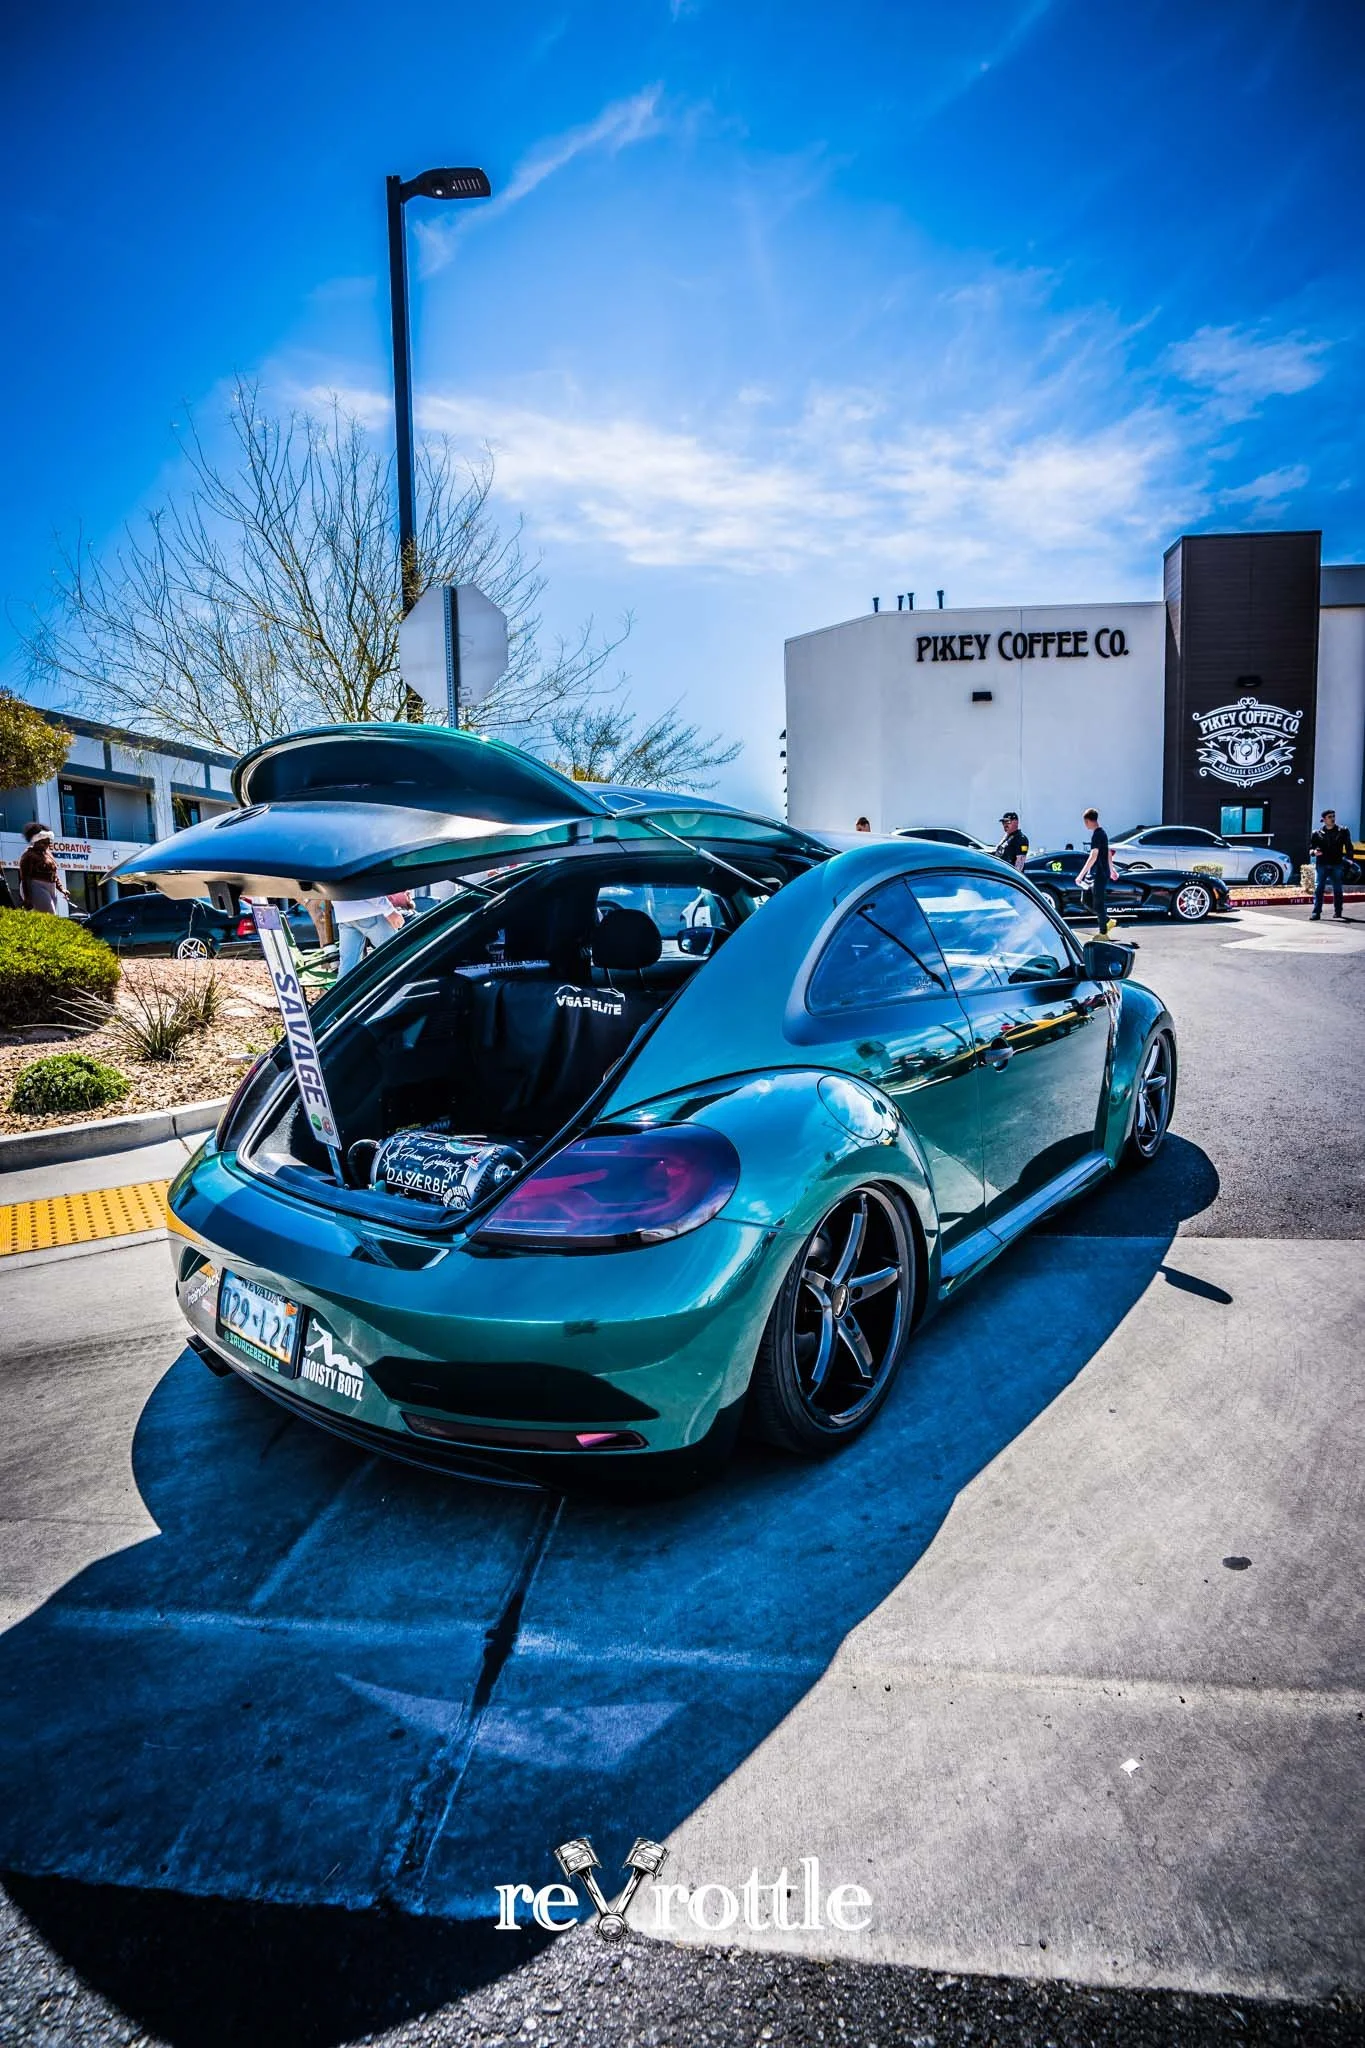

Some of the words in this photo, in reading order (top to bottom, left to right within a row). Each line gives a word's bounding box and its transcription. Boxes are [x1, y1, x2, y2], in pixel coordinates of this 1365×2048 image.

[916, 634, 991, 662] PIKEY
[998, 631, 1088, 661] COFFEE
[1094, 628, 1129, 658] CO.
[1200, 712, 1237, 734] PIKEY
[1238, 710, 1283, 727] COFFEE
[1247, 763, 1273, 775] CLASSICS
[48, 841, 92, 854] ECORATIVE
[1051, 862, 1062, 872] 62
[275, 971, 327, 1108] SAVAGE
[241, 1280, 280, 1305] NEVADA
[301, 1357, 337, 1390] MOISTY
[337, 1370, 363, 1401] BOYZ
